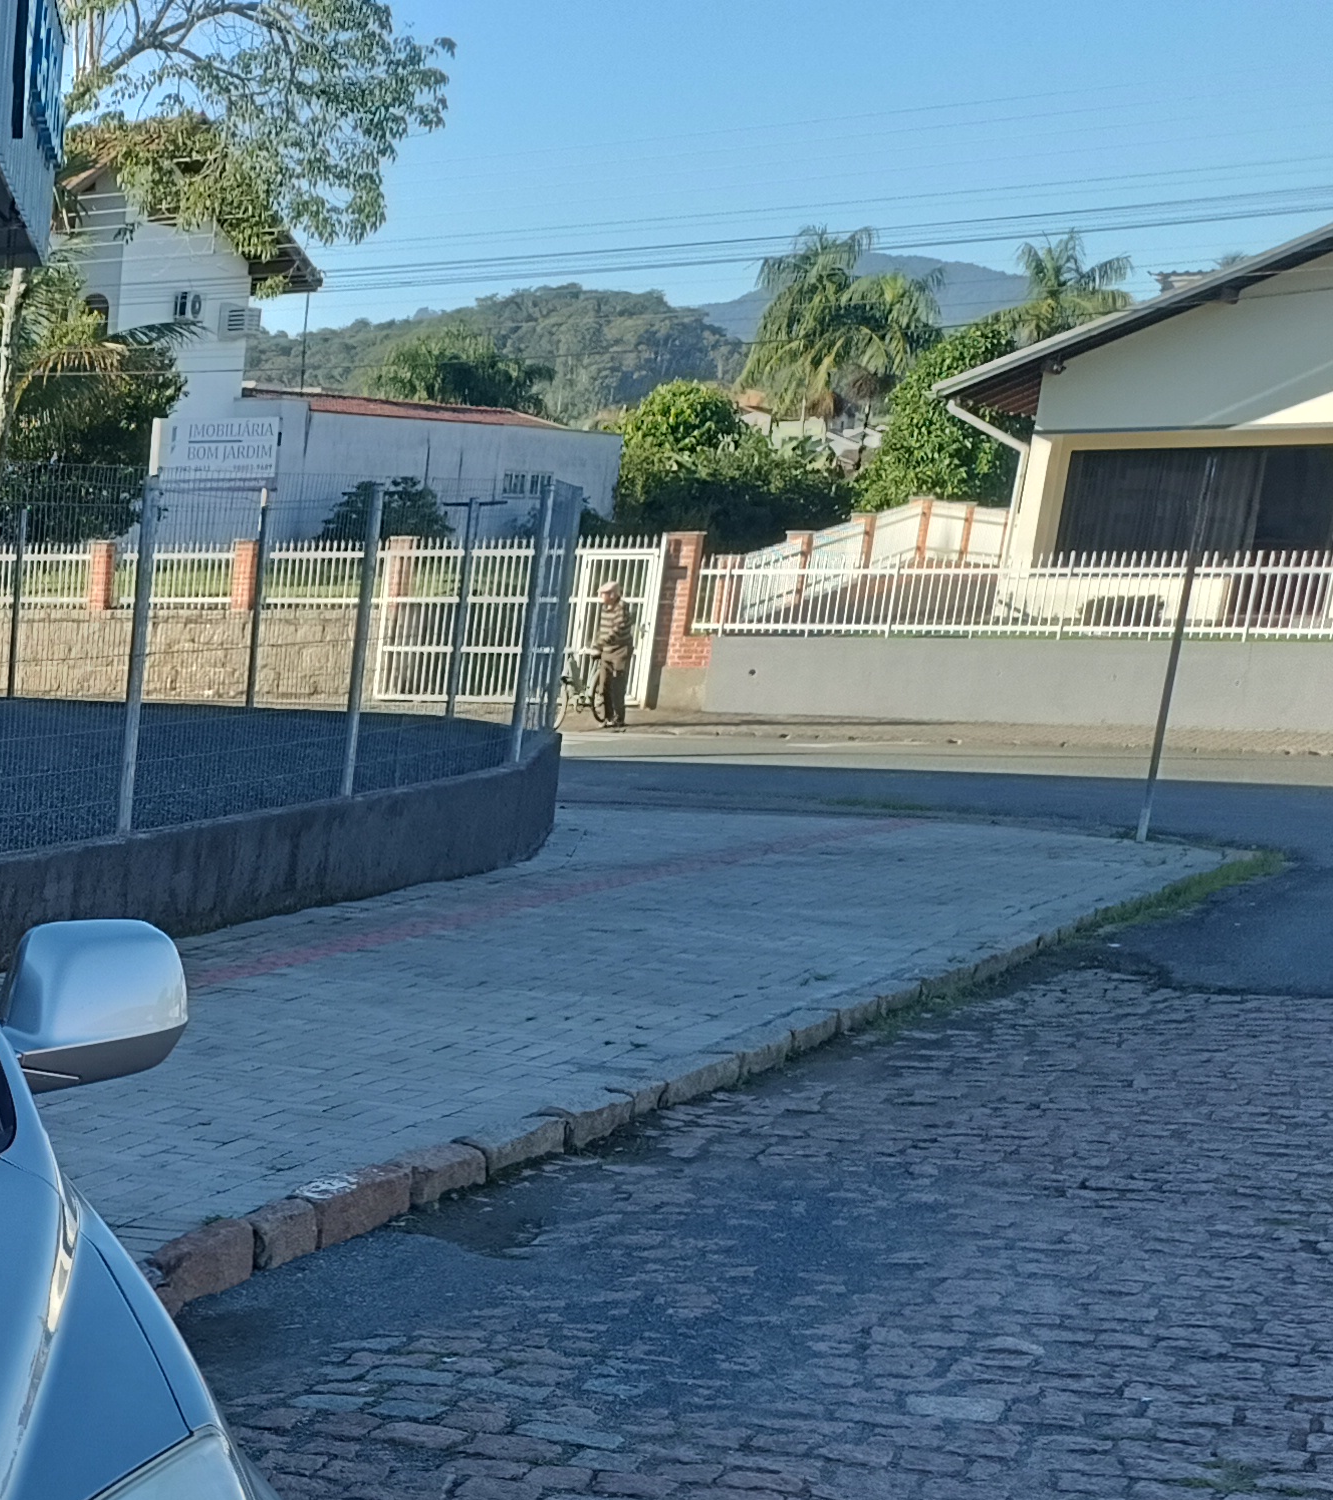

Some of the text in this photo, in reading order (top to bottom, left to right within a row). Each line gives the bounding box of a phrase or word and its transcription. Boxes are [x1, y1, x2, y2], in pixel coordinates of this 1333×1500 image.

[188, 420, 274, 439] IMOBILIÁRIA
[187, 444, 273, 463] BOM JARDIM
